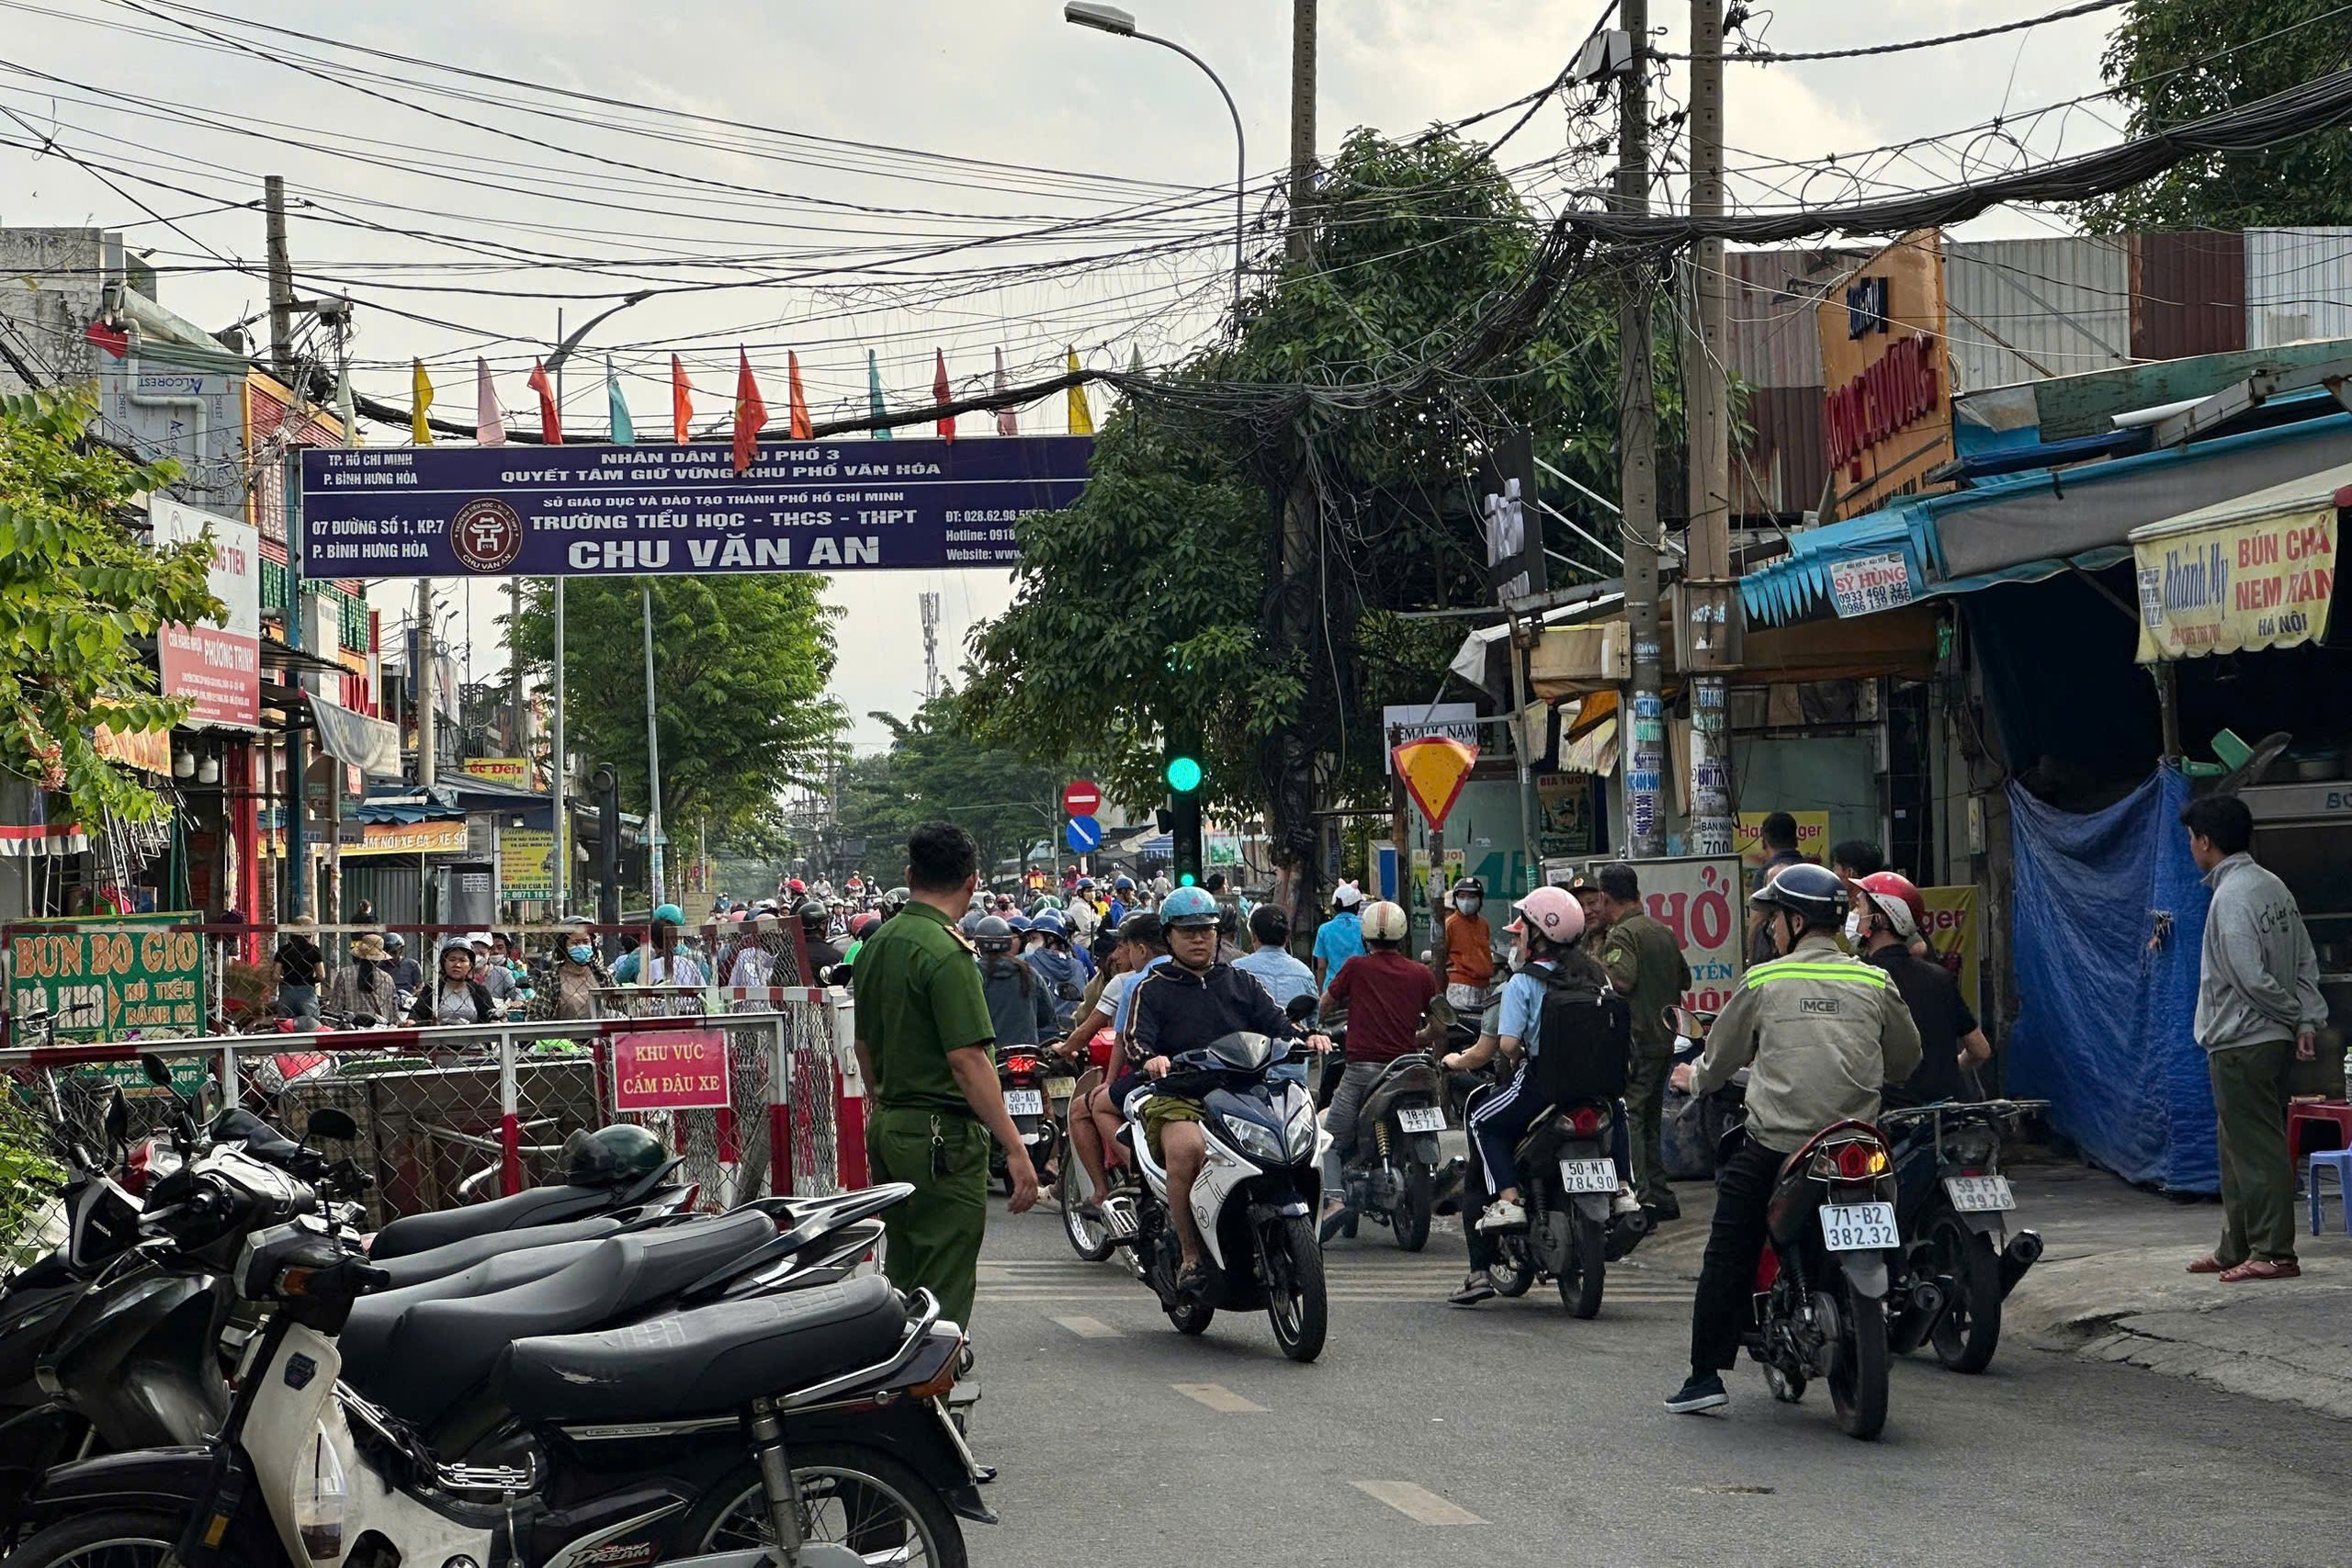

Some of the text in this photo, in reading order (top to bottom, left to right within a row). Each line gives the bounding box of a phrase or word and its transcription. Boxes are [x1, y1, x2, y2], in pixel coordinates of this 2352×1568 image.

[328, 454, 343, 466] TP.
[363, 452, 380, 466] CHÍ
[384, 454, 413, 466] MINH
[601, 446, 840, 464] NHÂN DÂN KU PHỐ 3
[323, 469, 418, 485] P. BÌNH HƯNG HÒA
[502, 461, 941, 482] QUYẾT TÂM GIỮ VỮNG KHU PHỐ VĂN HÓA
[567, 496, 602, 507] GIÁO
[605, 497, 634, 508] DỤC
[639, 496, 658, 506] VÀ
[662, 495, 691, 505] ĐÀO
[695, 496, 722, 506] TẠO
[727, 493, 775, 504] THÀNH
[779, 491, 808, 503] PHỐ
[836, 491, 861, 502] CHÍ
[865, 492, 904, 502] MINH
[312, 515, 445, 536] 07 ĐƯỜNG SỐ 1, KP.7
[530, 512, 628, 530] TRƯỜNG
[635, 509, 688, 528] TIỂU
[696, 513, 744, 530] HỌC
[770, 512, 832, 526] THCS
[857, 509, 918, 525] THPT
[945, 511, 961, 522] ĐT:
[946, 529, 987, 541] Hotline:
[2238, 515, 2332, 569] BÚN CHẢ
[312, 540, 428, 558] P. BÌNH HƯNG HÒA
[568, 533, 879, 569] CHU VĂN AN
[946, 549, 991, 560] Website:
[462, 554, 481, 568] CHU
[501, 554, 512, 564] AN
[1858, 567, 1906, 588] HÙNG
[1839, 581, 1909, 604] 0933 460 322
[2235, 564, 2334, 611] NEM RÁN
[1842, 592, 1911, 615] 0986 139 096
[2278, 611, 2308, 635] NỘI
[1447, 724, 1476, 739] NAM
[401, 835, 413, 847] XE
[438, 833, 450, 845] XE
[1645, 865, 1731, 950] HỞ
[58, 985, 104, 1028] KHO
[1804, 1001, 1836, 1011] MCE
[636, 1041, 704, 1063] KHU VỰC
[623, 1071, 719, 1096] CẤM ĐẬU XE
[1009, 1103, 1039, 1113] 967.17
[1568, 1162, 1605, 1175] 50-N1
[1567, 1176, 1614, 1190] 784.90
[1955, 1177, 1997, 1193] 59-F1
[1956, 1193, 2010, 1208] 199.26
[1832, 1206, 1883, 1225] 71-B2
[1829, 1225, 1894, 1246] 382.32
